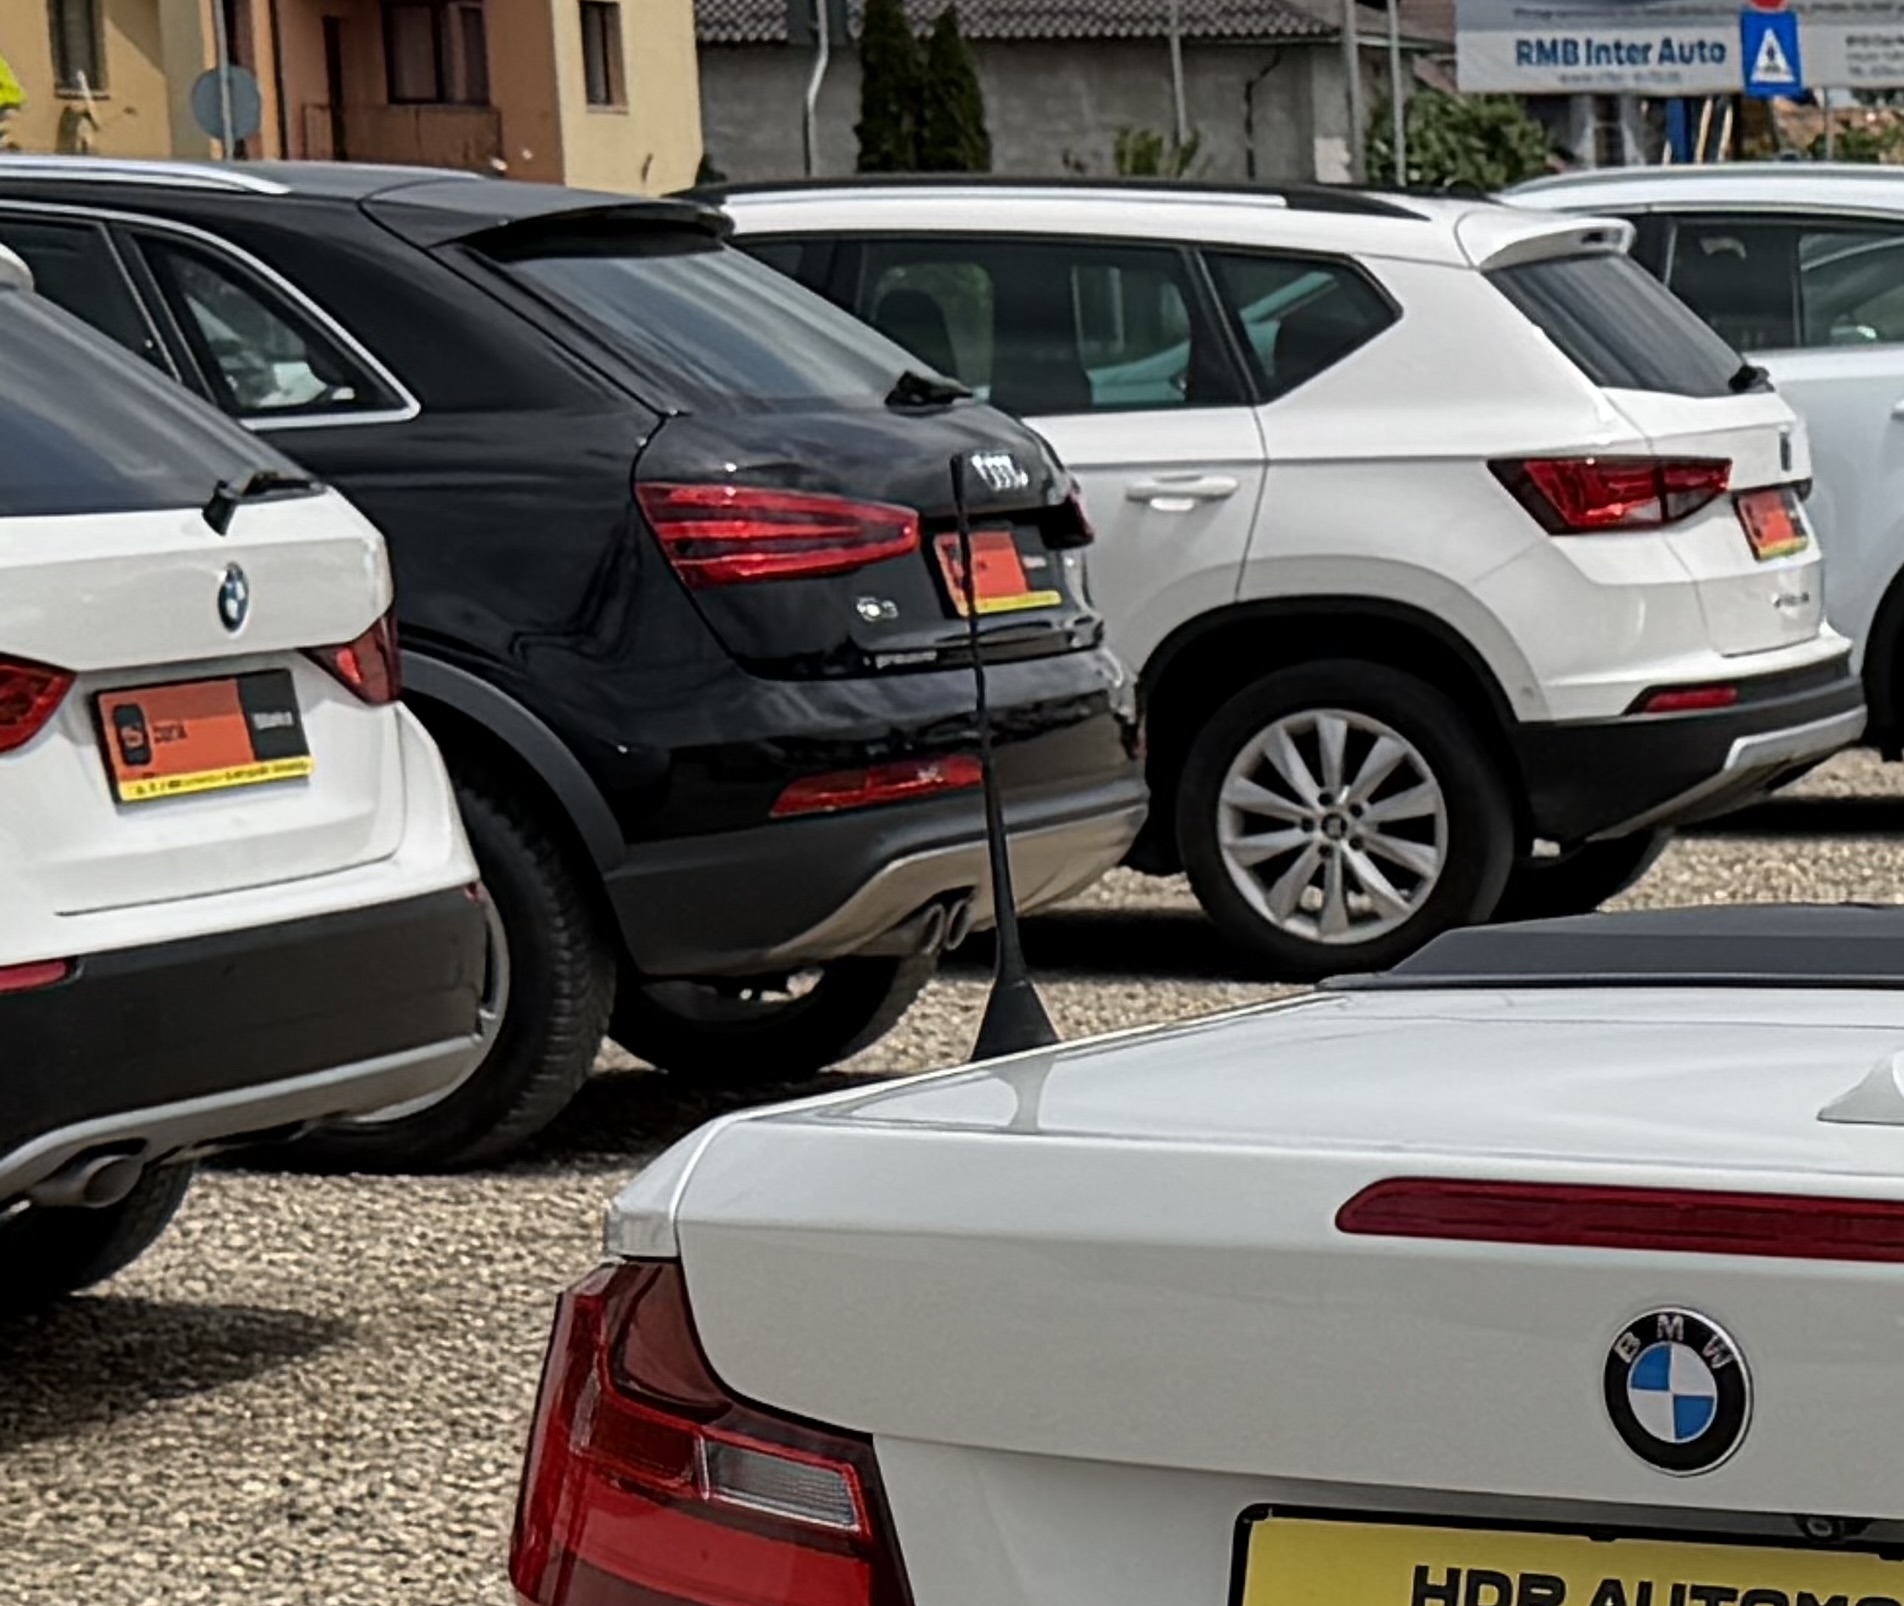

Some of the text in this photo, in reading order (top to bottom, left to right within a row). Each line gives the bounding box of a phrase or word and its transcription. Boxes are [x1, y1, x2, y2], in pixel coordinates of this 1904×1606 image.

[1515, 36, 1727, 67] RMB Inter Auto
[1613, 1314, 1734, 1369] BMW
